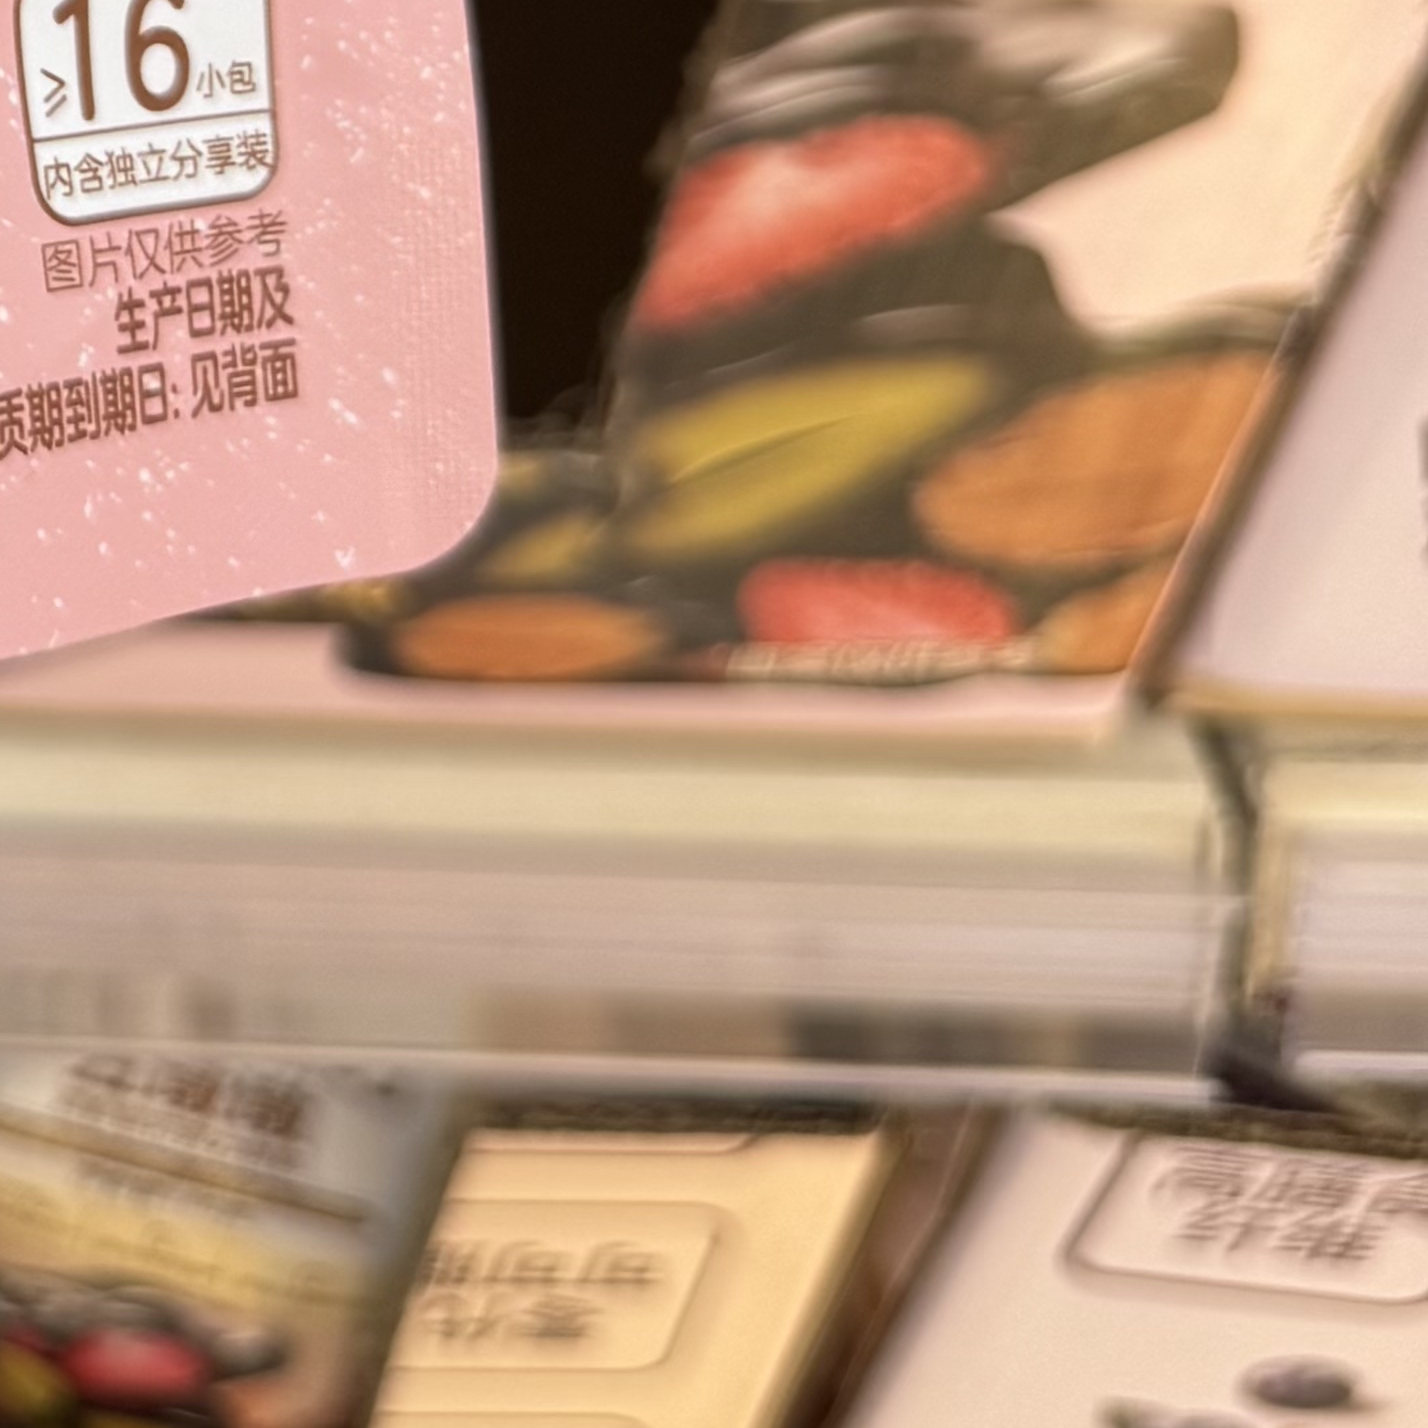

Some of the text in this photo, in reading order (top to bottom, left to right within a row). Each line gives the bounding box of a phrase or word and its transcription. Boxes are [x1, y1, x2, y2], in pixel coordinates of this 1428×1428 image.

[44, 130, 274, 200] 内含独立分享装
[43, 208, 288, 292] 图片仅供参考
[114, 266, 294, 356] 生产日期及
